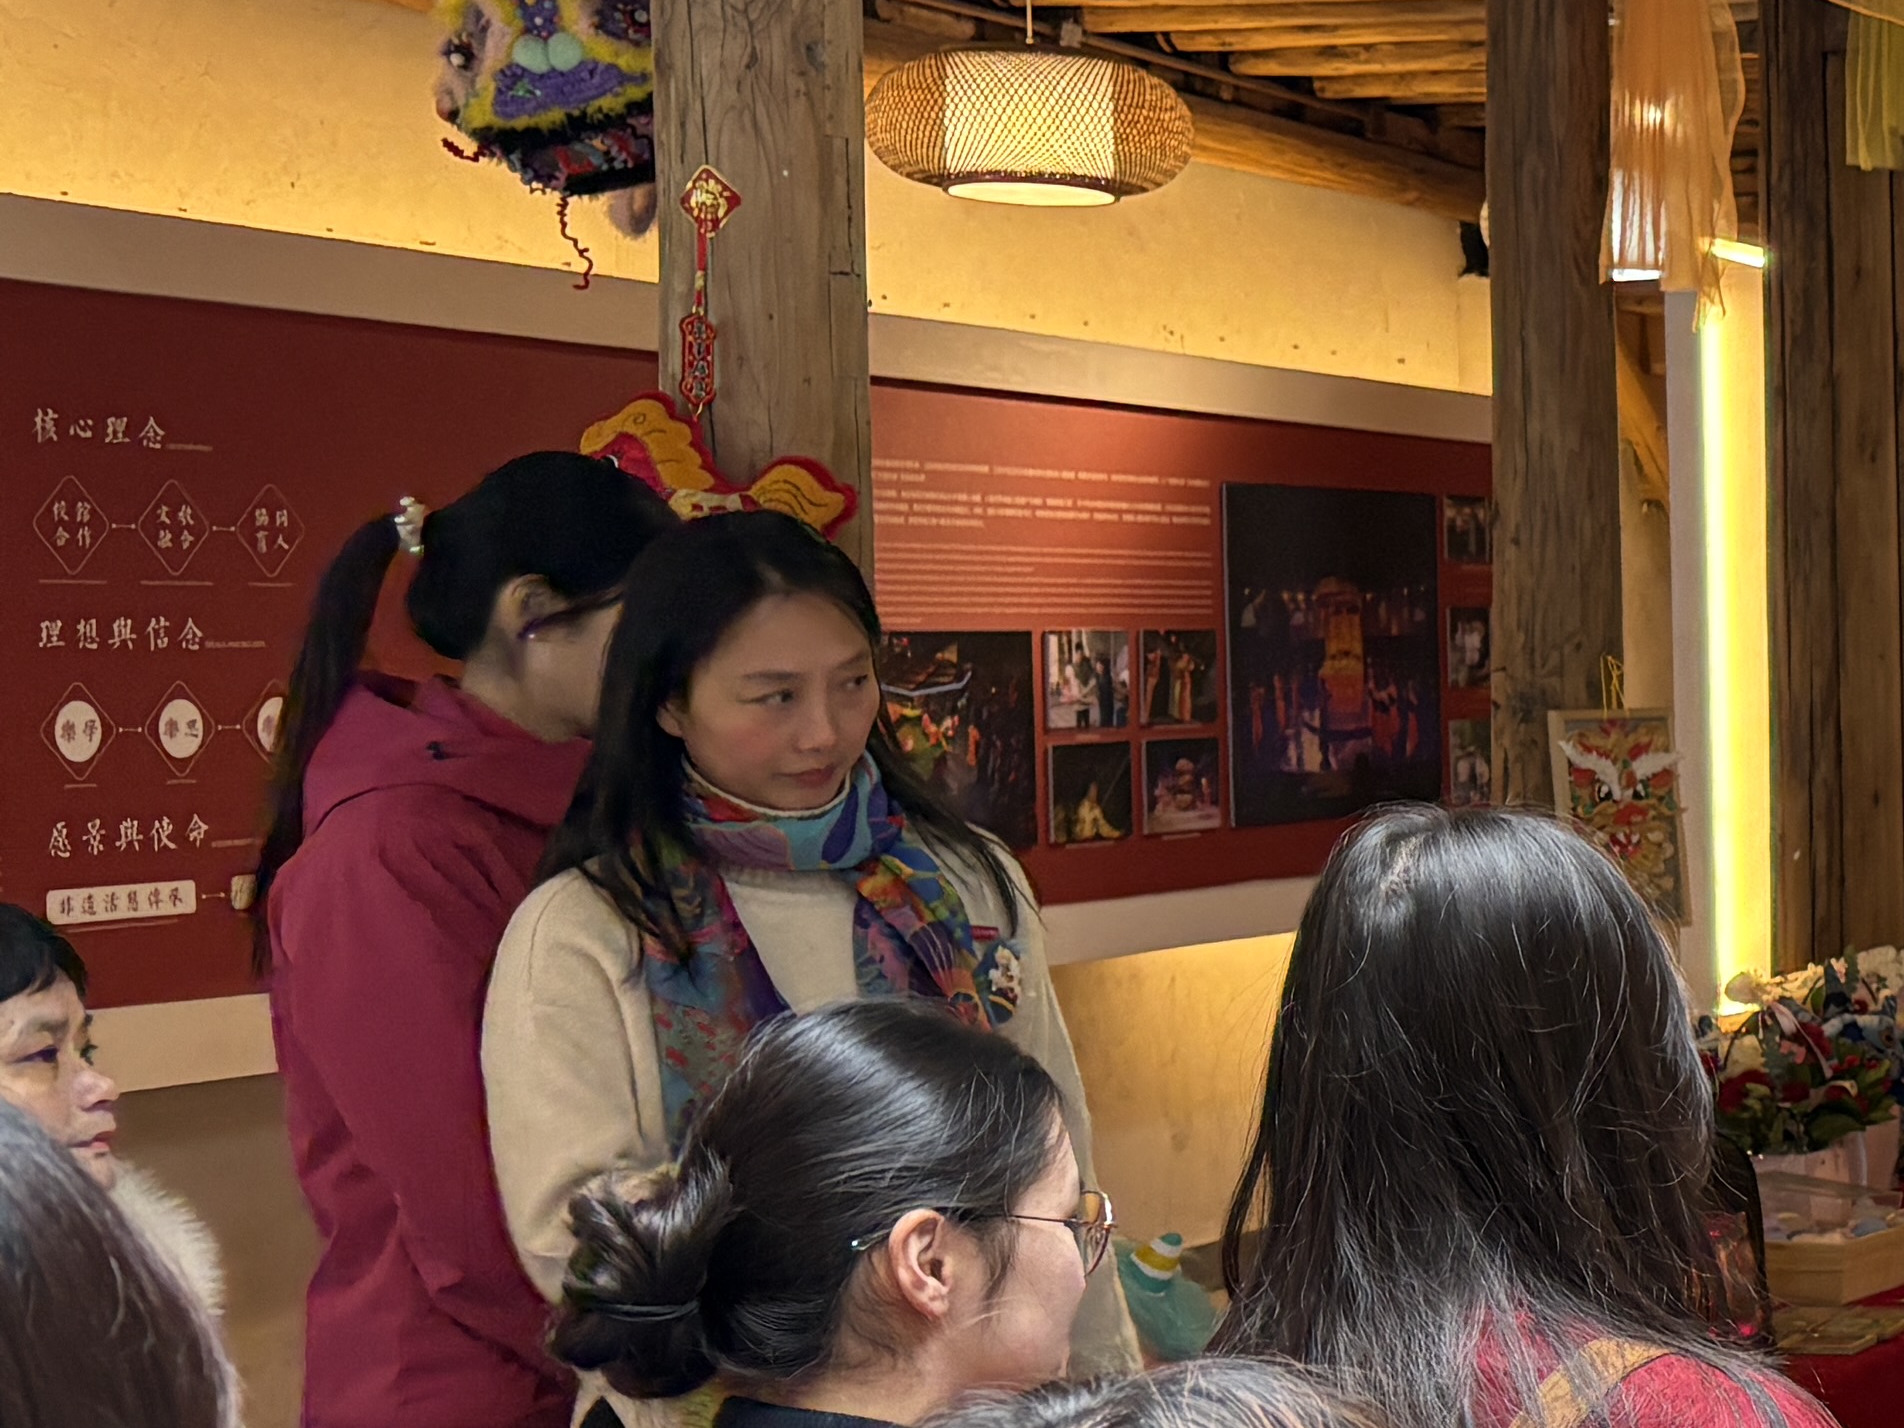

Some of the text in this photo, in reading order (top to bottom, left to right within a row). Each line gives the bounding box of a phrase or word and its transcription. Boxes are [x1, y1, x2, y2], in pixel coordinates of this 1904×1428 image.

[32, 408, 167, 449] 核心理念
[38, 615, 204, 652] 理想與信念
[48, 813, 210, 859] 愿景與使命
